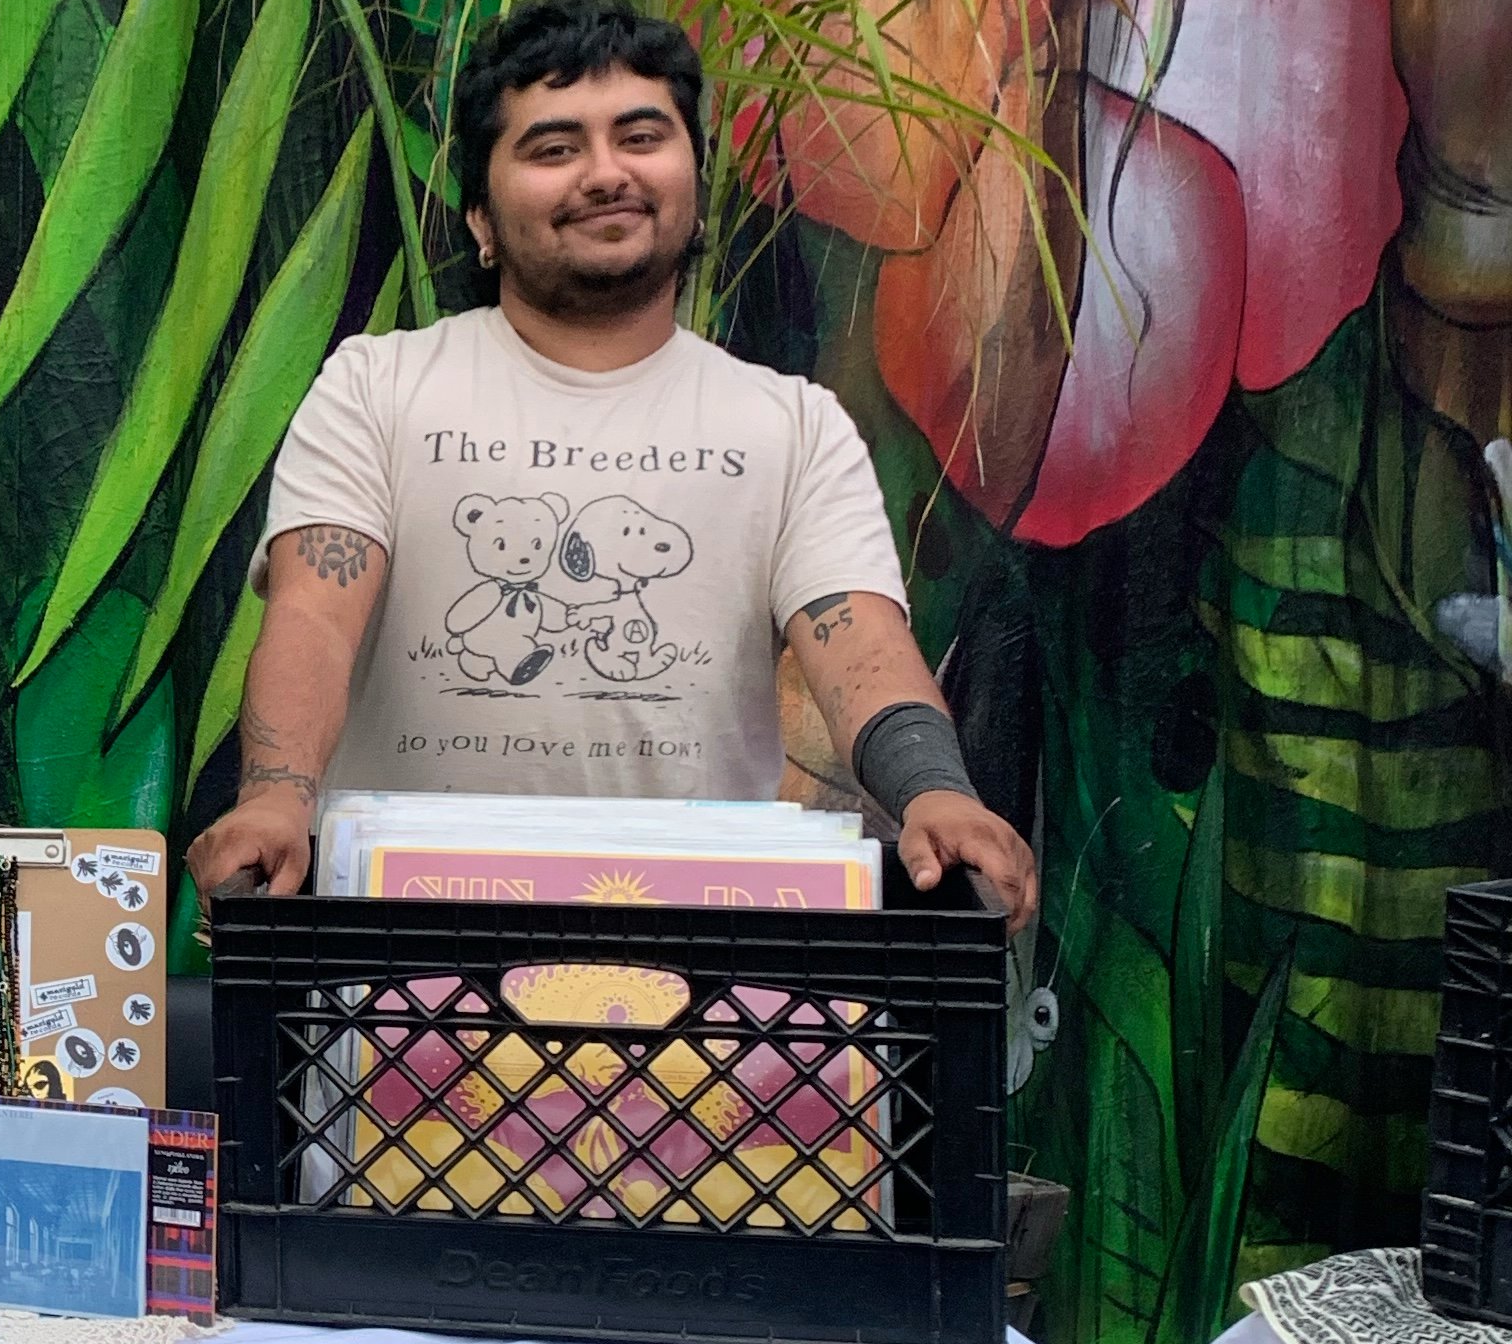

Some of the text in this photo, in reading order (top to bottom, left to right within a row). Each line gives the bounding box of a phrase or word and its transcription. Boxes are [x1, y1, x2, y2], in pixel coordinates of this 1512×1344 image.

[424, 430, 747, 477] The Breeders
[814, 607, 853, 647] 9-5
[397, 734, 427, 753] do
[437, 734, 488, 756] you
[502, 734, 575, 757] love
[588, 738, 627, 758] me
